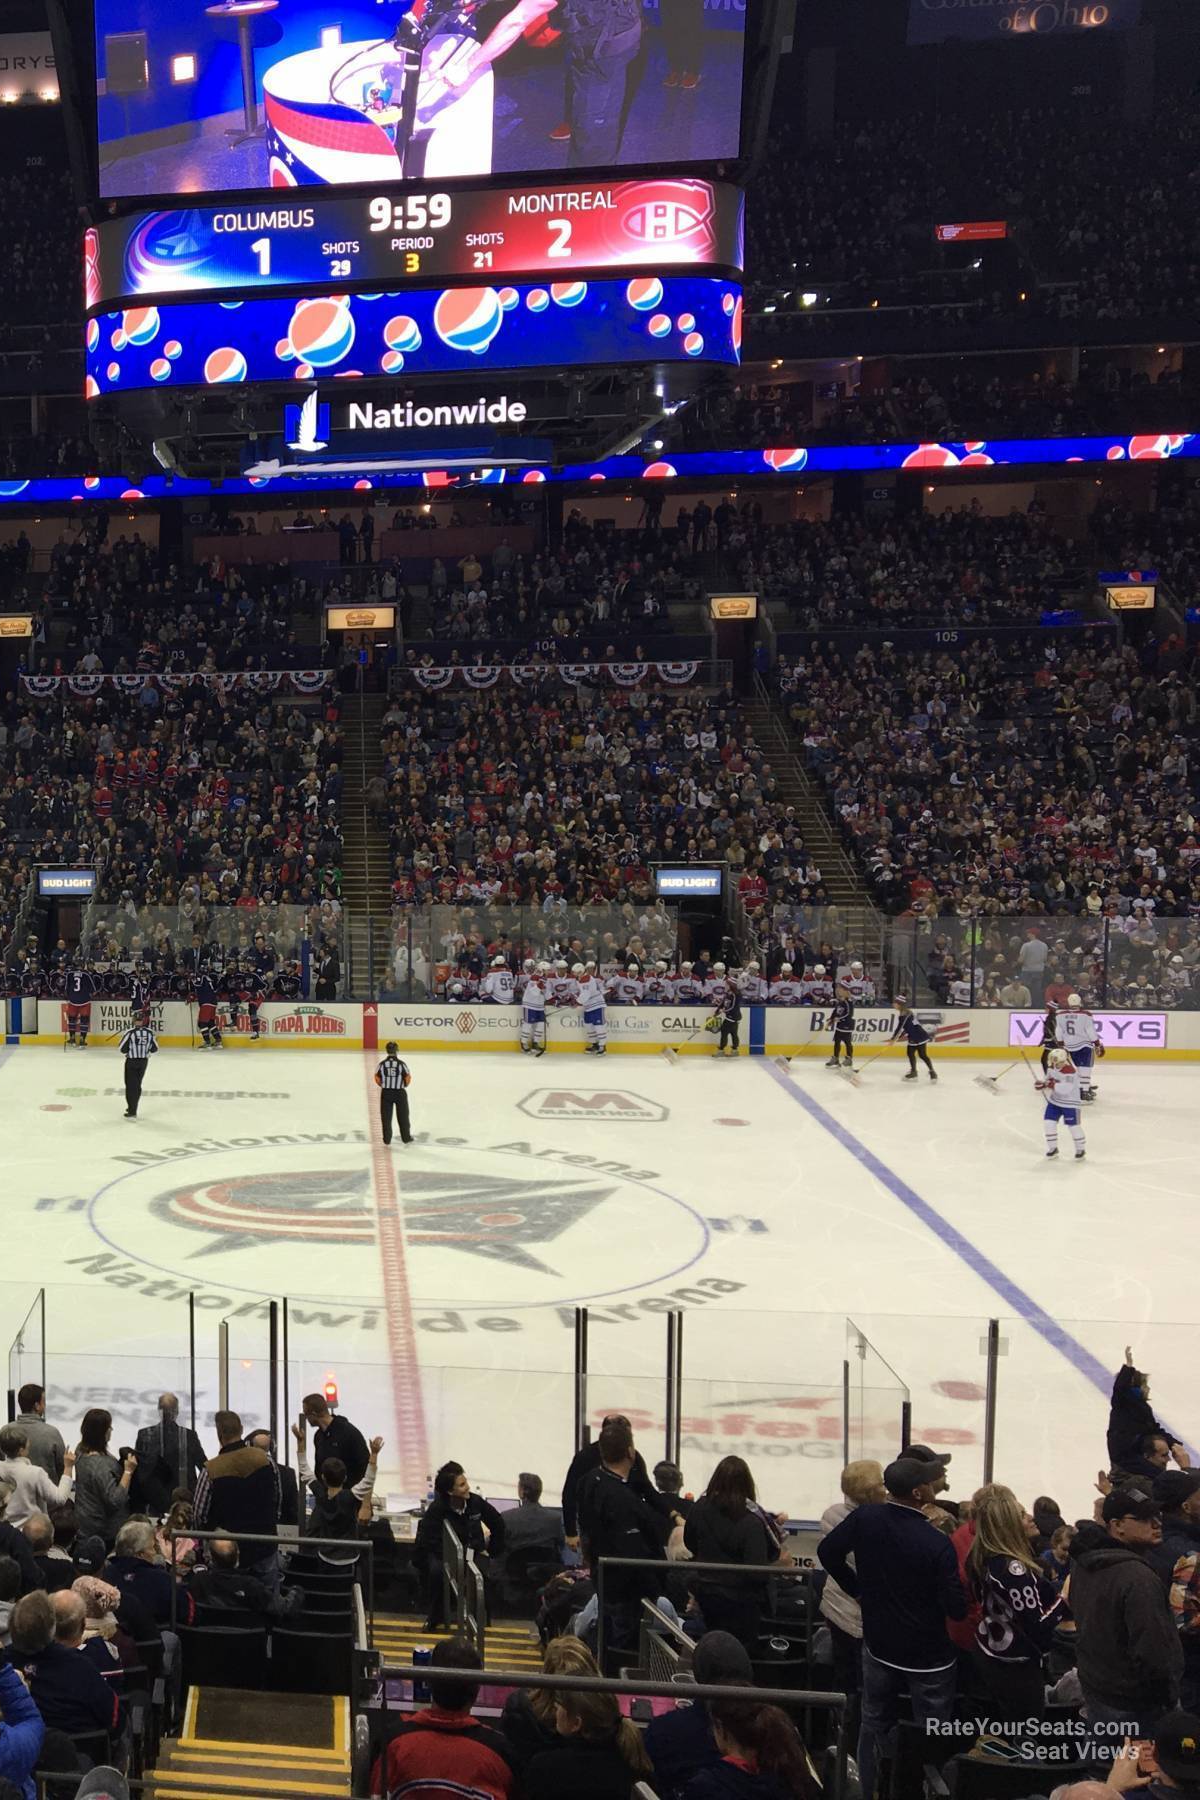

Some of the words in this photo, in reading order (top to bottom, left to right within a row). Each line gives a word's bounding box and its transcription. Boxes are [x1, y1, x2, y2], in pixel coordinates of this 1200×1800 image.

[508, 191, 618, 214] MONTREAL
[213, 208, 315, 233] COLUMBUS
[369, 194, 452, 232] 9:59
[391, 236, 434, 250] PERIOD
[465, 232, 505, 247] SHOTS
[547, 219, 573, 257] 2
[322, 241, 360, 255] SHOTS
[251, 238, 272, 276] 1
[405, 253, 420, 272] 3
[473, 252, 493, 268] 21
[330, 260, 352, 276] 29
[349, 396, 528, 429] Nationwide
[935, 631, 958, 642] 105
[535, 640, 557, 651] 104
[43, 879, 62, 887] BUD
[64, 879, 93, 887] LIGHT
[660, 878, 683, 887] BUD
[685, 878, 717, 887] LIGHT
[73, 977, 81, 992] 3
[275, 1016, 304, 1032] PAPA
[306, 1015, 344, 1033] JOHNS
[394, 1017, 454, 1027] VECTOR
[625, 1016, 649, 1029] Gas
[662, 1017, 700, 1028] CALL
[1016, 1020, 1161, 1040] VRYS
[1066, 1020, 1075, 1036] 6
[137, 1036, 149, 1047] 75
[103, 1087, 291, 1100] Hntington
[537, 1108, 654, 1117] MARATHON
[488, 1141, 661, 1181] Arena
[554, 1277, 747, 1328] Arena
[1008, 1585, 1037, 1611] 88
